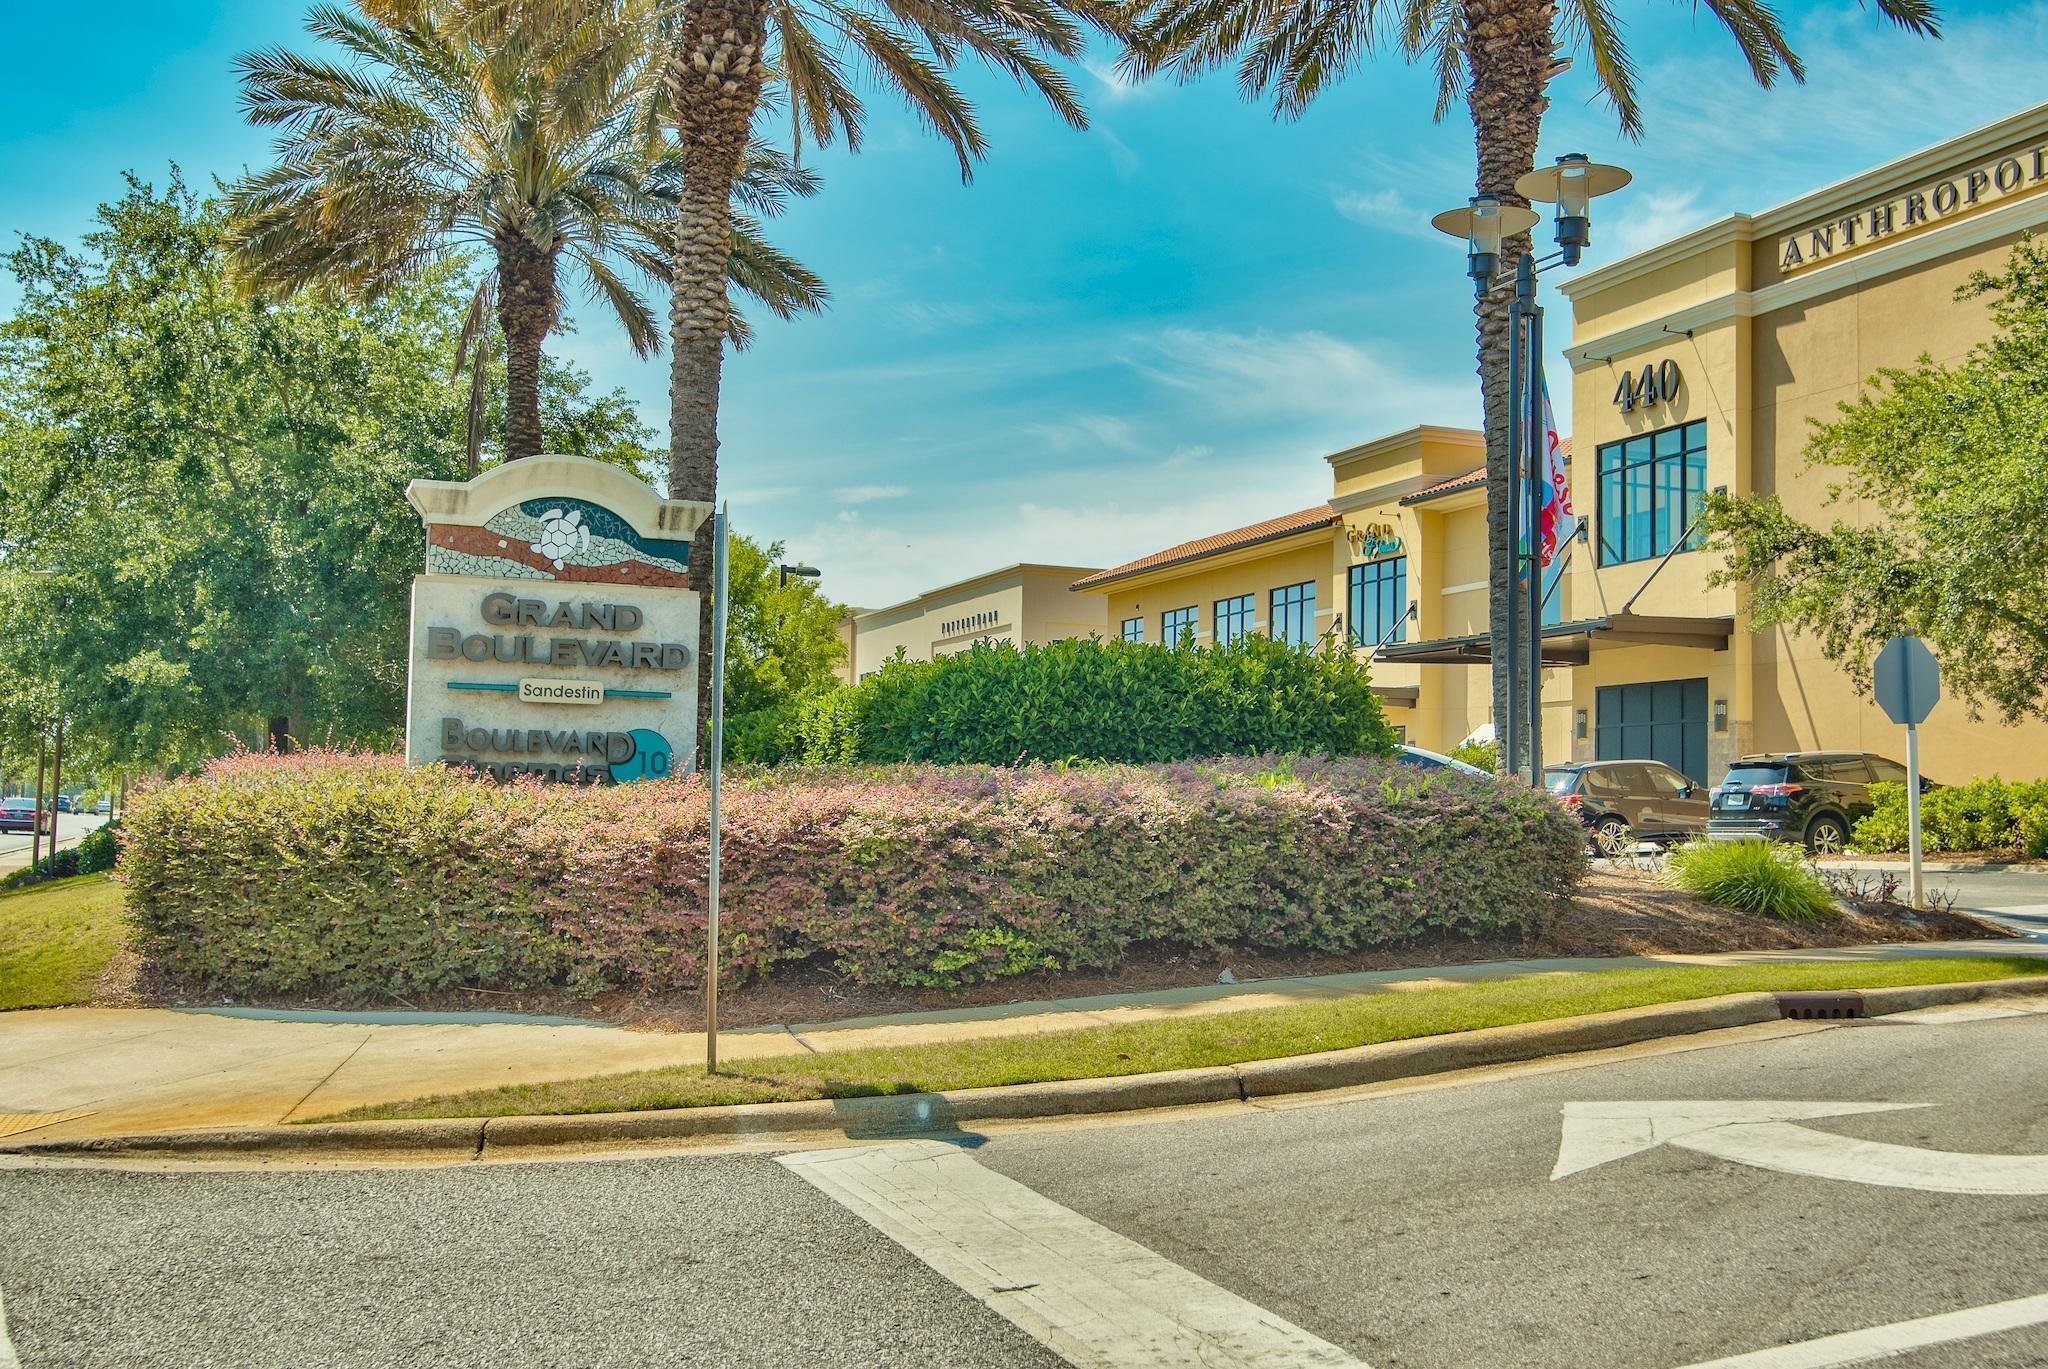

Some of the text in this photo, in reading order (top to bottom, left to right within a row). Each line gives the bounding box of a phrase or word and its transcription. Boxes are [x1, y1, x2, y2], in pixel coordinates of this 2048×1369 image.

[1780, 146, 2048, 268] ANTHROPOL
[1613, 359, 1680, 414] 440
[480, 592, 644, 632] GRAND
[426, 626, 691, 670] BOULEVARD
[523, 683, 600, 699] Sandestin
[441, 717, 636, 765] BOULEVARD
[639, 751, 667, 775] 10
